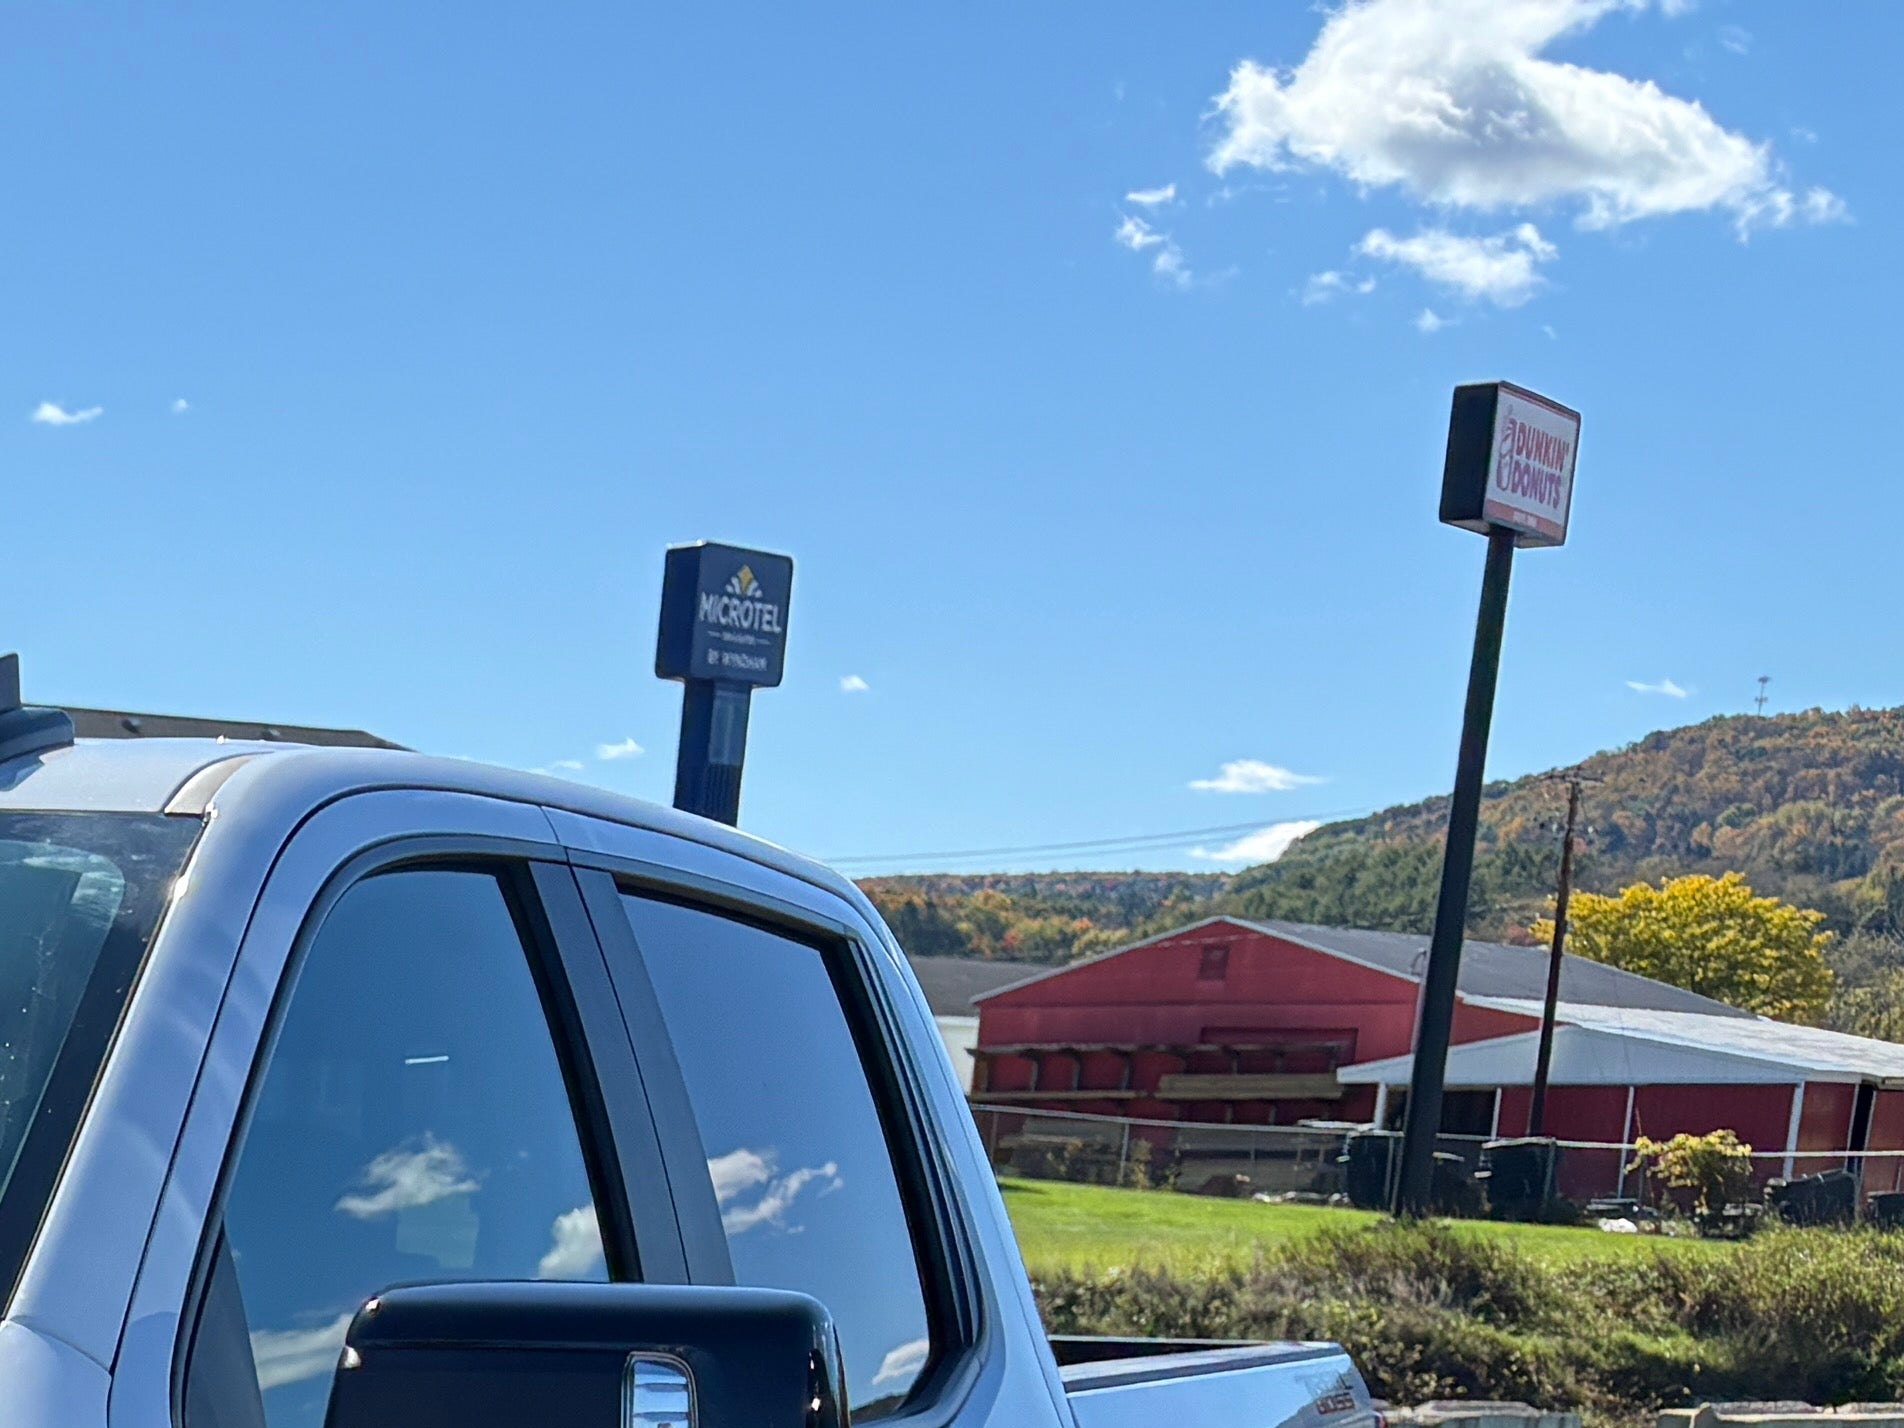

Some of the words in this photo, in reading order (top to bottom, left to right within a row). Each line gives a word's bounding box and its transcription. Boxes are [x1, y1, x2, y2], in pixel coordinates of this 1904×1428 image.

[1515, 421, 1570, 474] DUNKIN'
[1511, 459, 1562, 510] DONUTS
[698, 591, 783, 634] MICROTEL
[1316, 1392, 1356, 1416] BOSS
